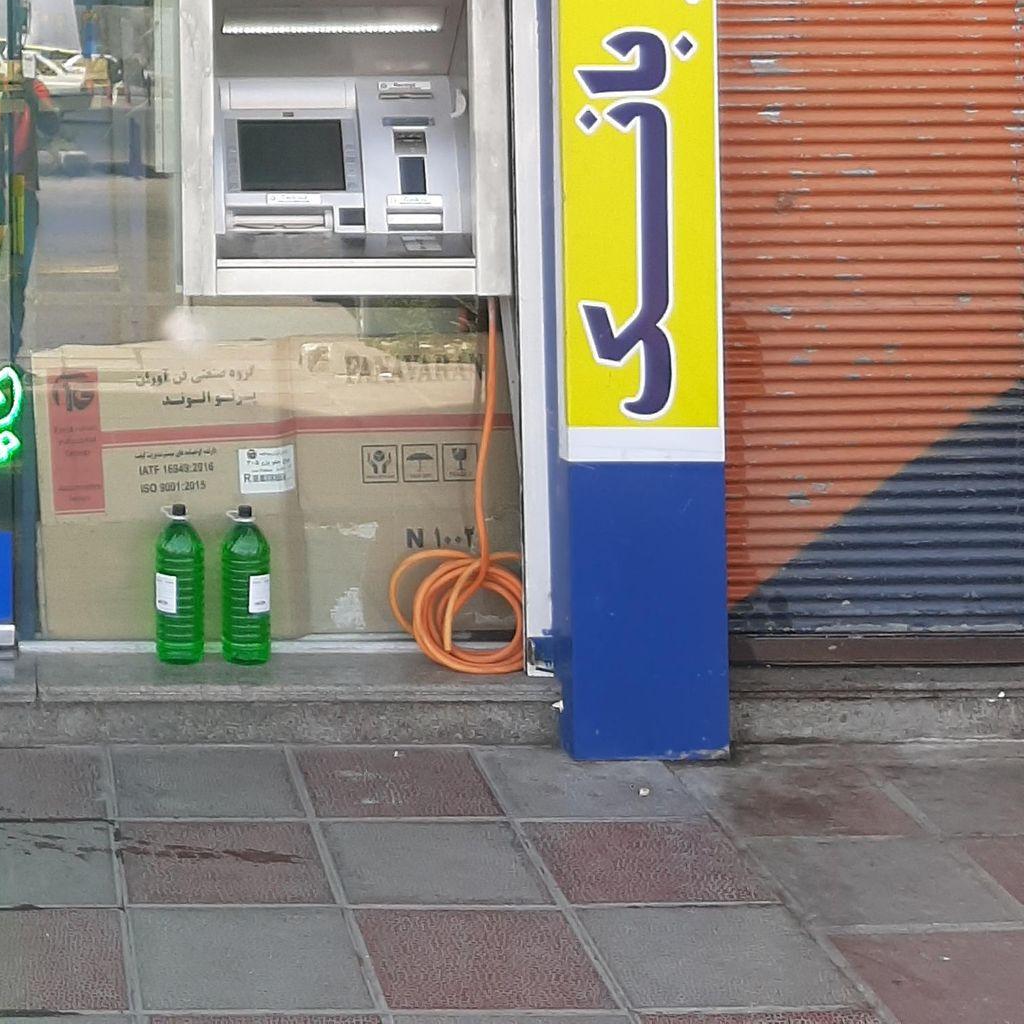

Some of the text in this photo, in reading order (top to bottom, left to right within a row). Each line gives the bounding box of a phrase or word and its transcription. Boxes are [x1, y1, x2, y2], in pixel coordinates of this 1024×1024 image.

[574, 27, 697, 419] بانک
[162, 390, 211, 408] الوند
[139, 464, 160, 476] IATF
[140, 482, 157, 493] ISO
